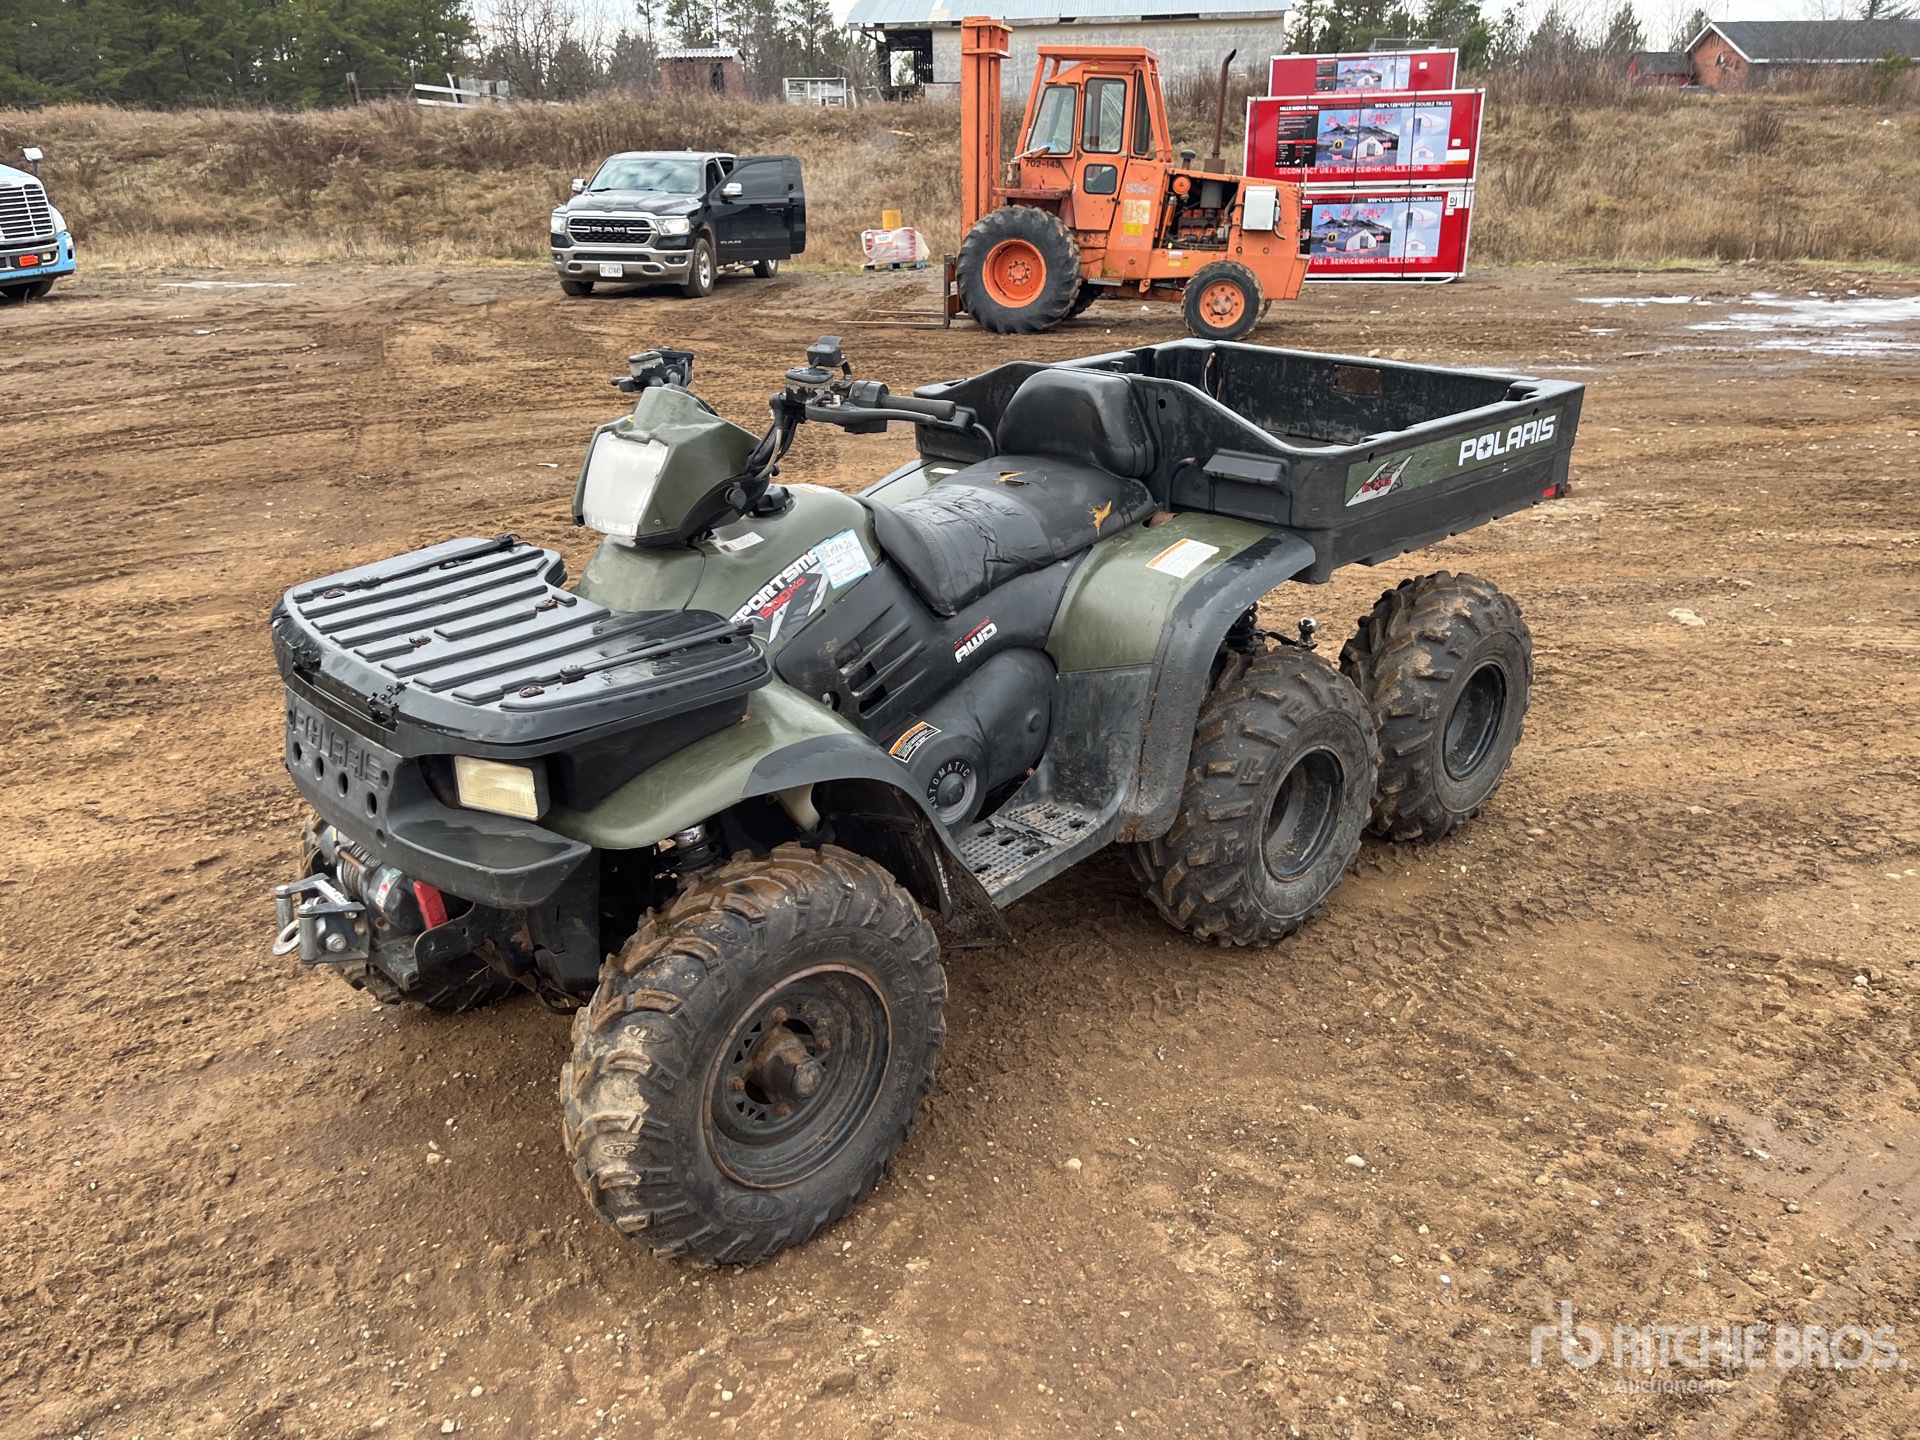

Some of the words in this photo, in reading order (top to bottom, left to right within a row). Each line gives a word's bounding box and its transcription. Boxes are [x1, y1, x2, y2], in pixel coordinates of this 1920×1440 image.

[1025, 160, 1061, 169] 702-143
[1336, 165, 1424, 174] SERVCE@HK-HILLS.COM
[1458, 415, 1556, 467] POLARIS
[729, 549, 818, 623] PORTSMA
[759, 589, 793, 619] 500
[955, 623, 998, 663] AWD
[928, 761, 971, 810] AUTOMATIC
